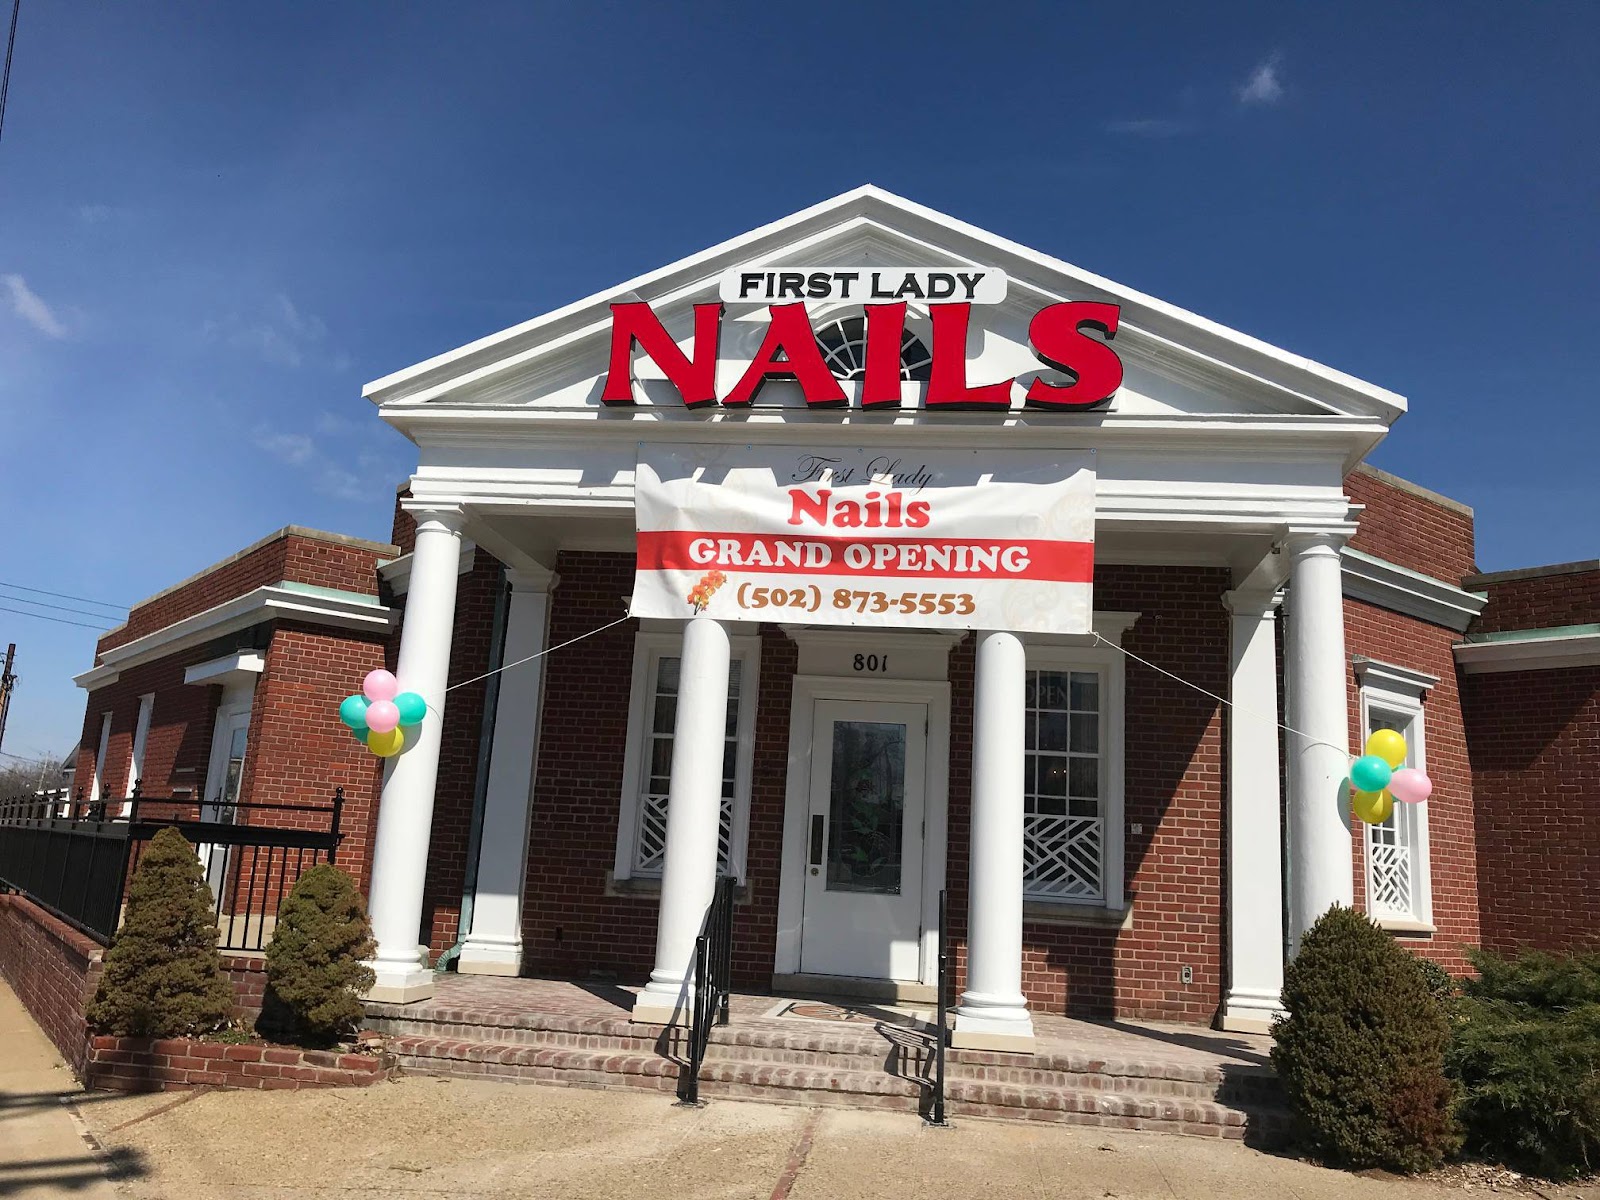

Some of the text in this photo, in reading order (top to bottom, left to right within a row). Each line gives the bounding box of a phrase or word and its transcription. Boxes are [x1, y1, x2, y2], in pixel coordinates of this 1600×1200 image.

[739, 272, 986, 299] FIRST LADY
[601, 301, 1124, 410] NAILS
[791, 454, 935, 496] First Lady
[787, 489, 931, 529] Nails
[688, 538, 1032, 574] GRAND OPENING
[737, 582, 976, 615] (502) 873-5553
[853, 653, 888, 671] 801
